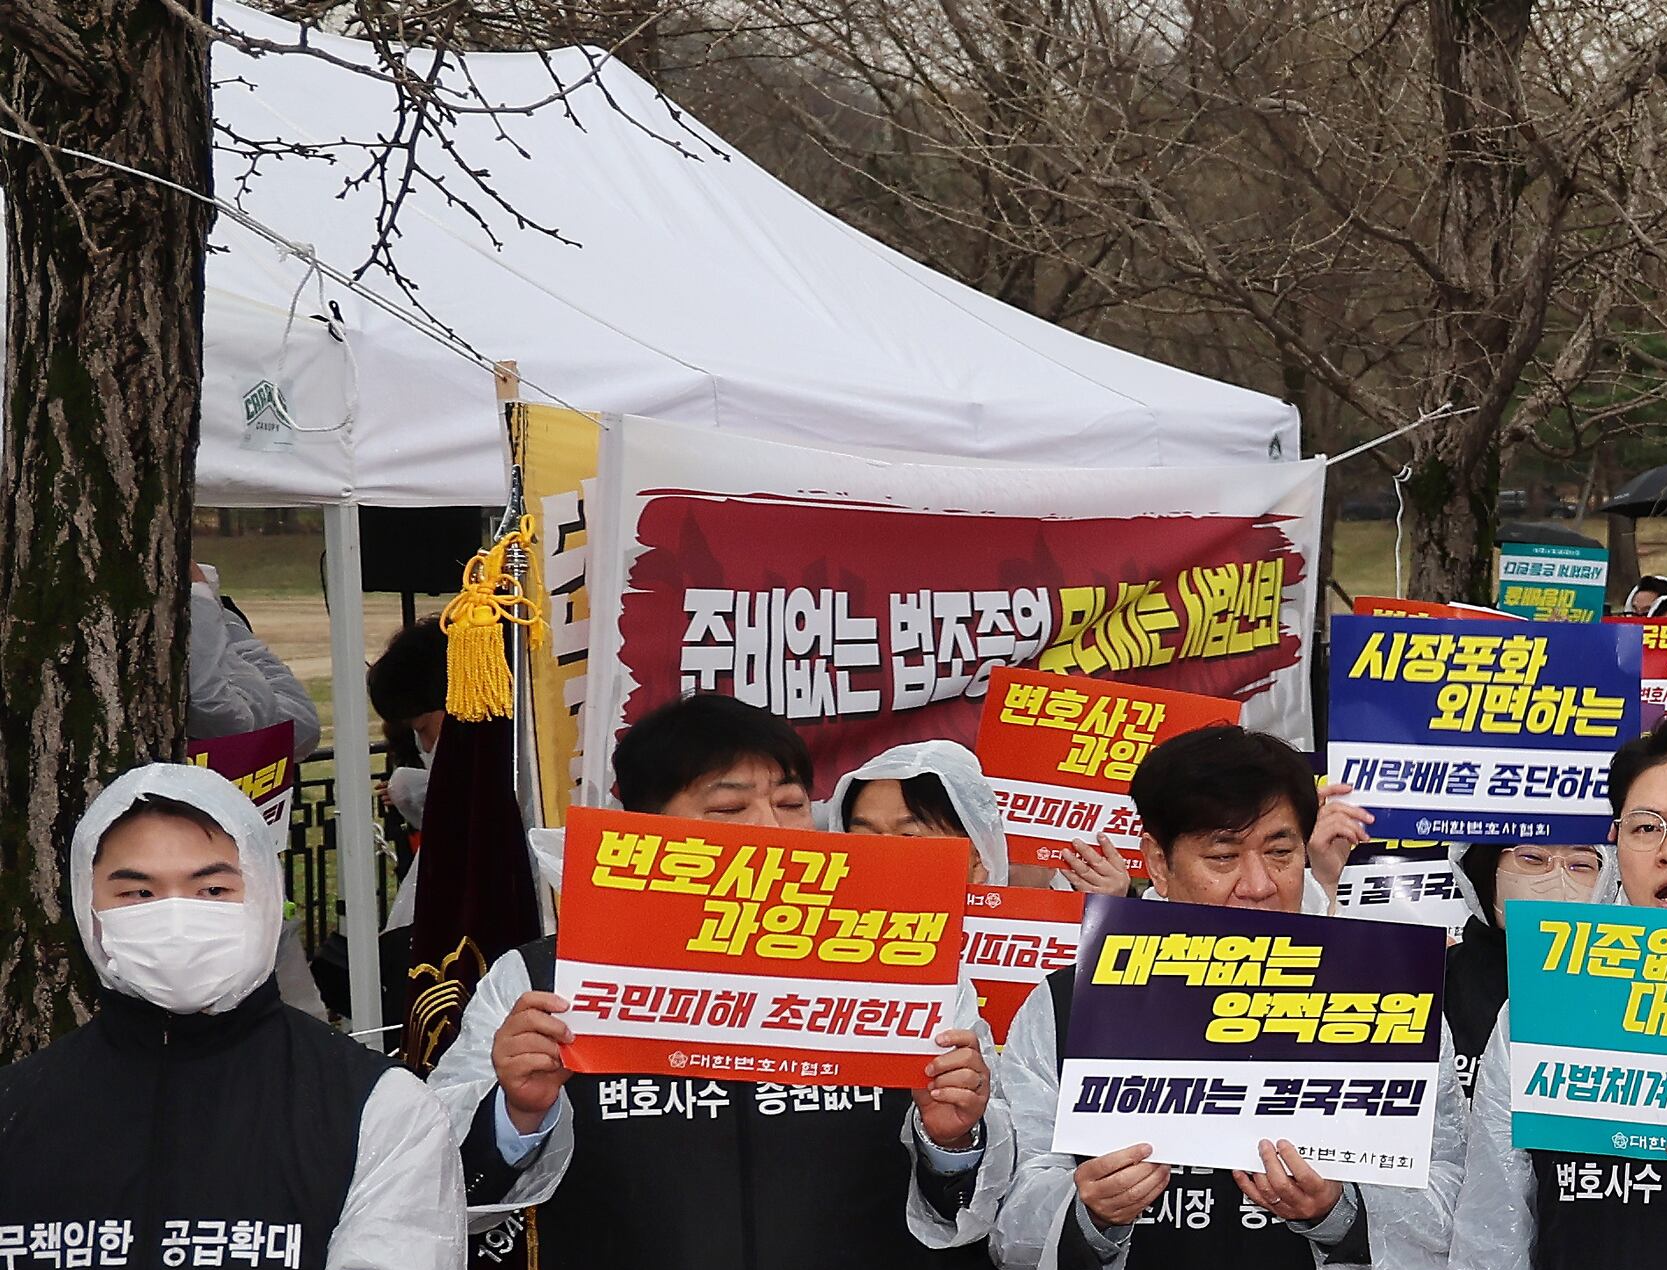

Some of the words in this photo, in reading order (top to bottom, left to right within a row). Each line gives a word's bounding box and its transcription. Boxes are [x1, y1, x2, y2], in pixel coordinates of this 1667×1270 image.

[679, 586, 881, 719] 준비없는
[1348, 632, 1548, 686] 시장포화
[1000, 682, 1166, 743] 변호사간
[1428, 683, 1625, 737] 외면하는
[1056, 733, 1154, 782] 과잉
[1340, 758, 1481, 796] 대량배출
[1432, 819, 1550, 837] 대한변호사협회
[590, 829, 851, 904] 변호사간
[1362, 873, 1463, 906] 결국국
[686, 899, 951, 967] 과잉경쟁
[1091, 932, 1323, 987] 대책없는
[571, 980, 760, 1027] 국민피해
[760, 996, 943, 1040] 초래한다
[1204, 991, 1435, 1045] 양적증원
[689, 1054, 839, 1076] 대한변호사협회
[597, 1079, 730, 1121] 변호사수
[1072, 1074, 1249, 1115] 피해자는
[1254, 1078, 1427, 1117] 결국국민
[1296, 1145, 1414, 1169] 한변호사협회
[1556, 1161, 1662, 1203] 변호사수
[161, 1220, 302, 1270] 공급확대
